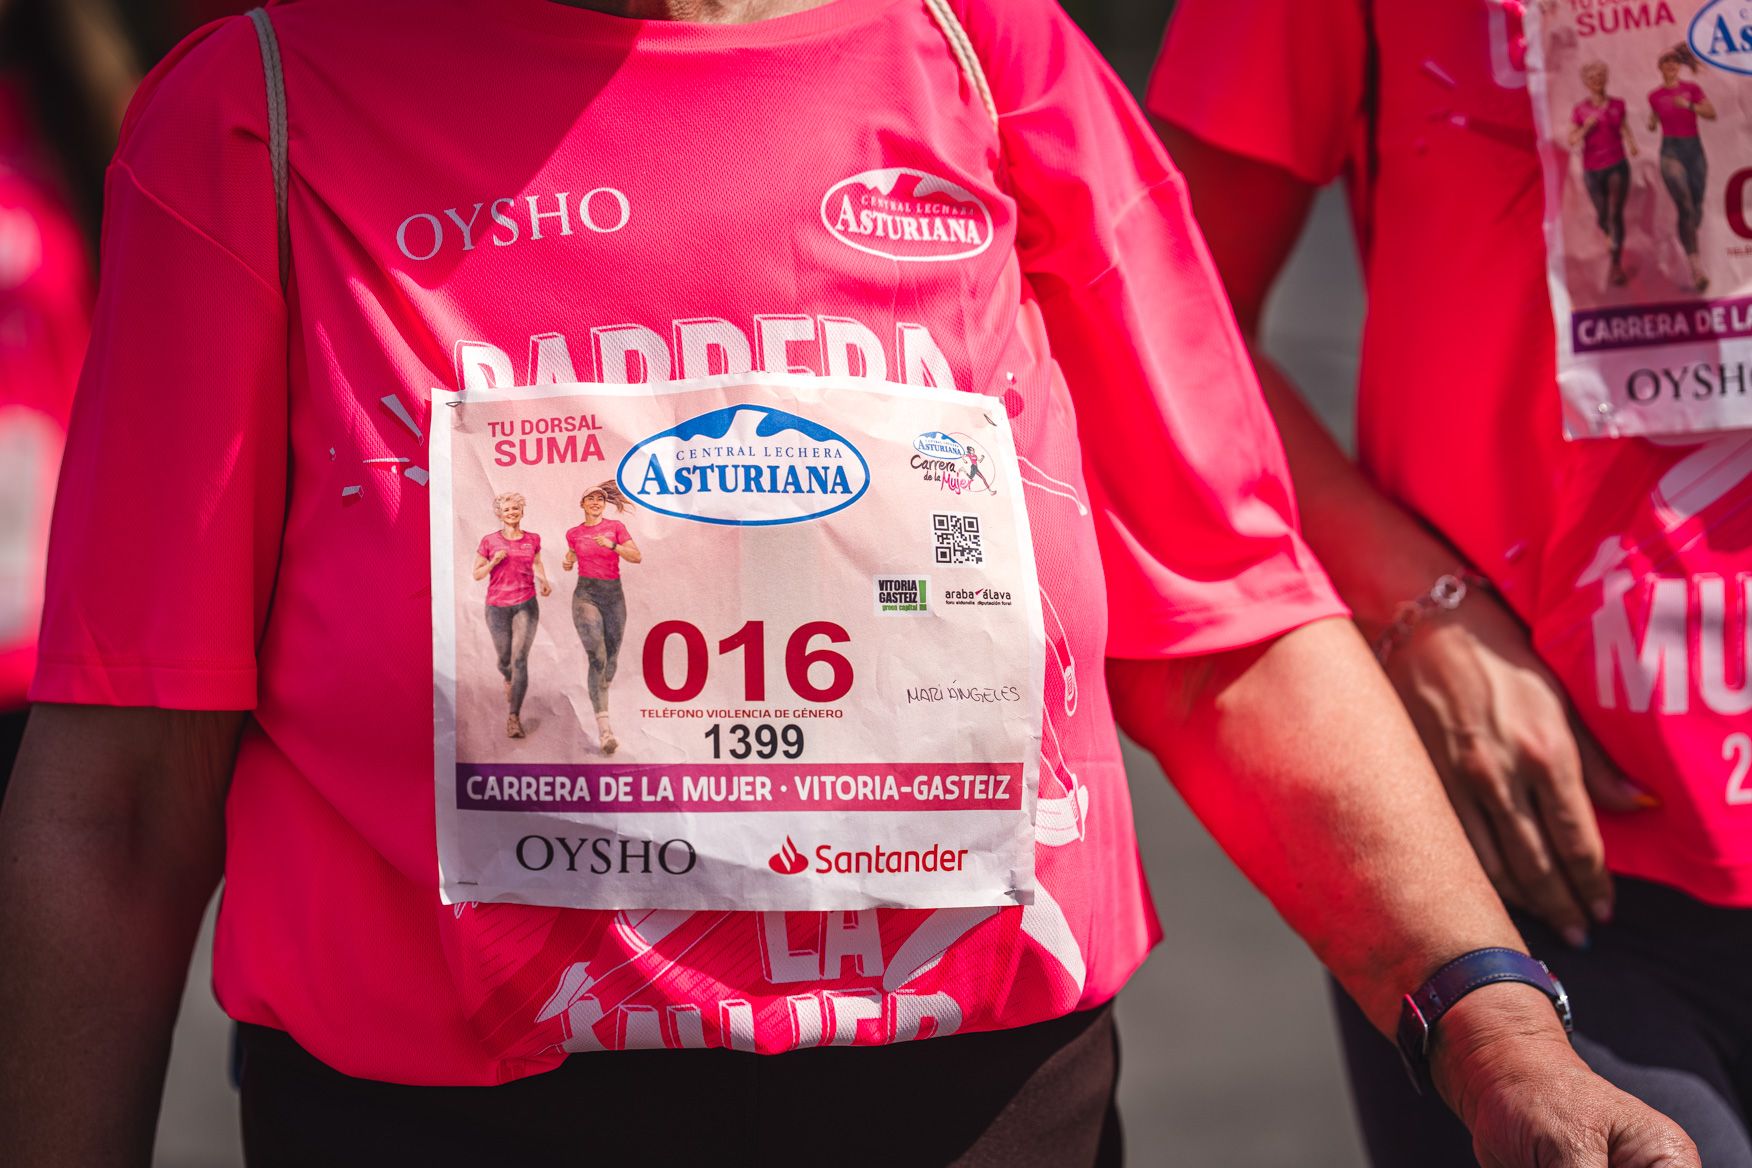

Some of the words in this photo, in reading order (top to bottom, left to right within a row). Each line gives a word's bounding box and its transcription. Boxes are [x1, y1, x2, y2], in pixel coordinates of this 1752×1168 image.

[1576, 2, 1677, 38] SUMA
[835, 194, 982, 245] ASTURIANA
[861, 195, 911, 212] CENTRAL
[916, 202, 975, 216] LECHERA
[396, 187, 631, 261] OYSHO
[1577, 312, 1690, 346] CARRERA
[1696, 306, 1727, 334] DE
[1627, 361, 1752, 404] OYSH
[488, 420, 514, 437] TU
[521, 414, 603, 436] DORSAL
[494, 433, 606, 467] SUMA
[676, 446, 756, 461] CENTRAL
[764, 446, 843, 459] LECHERA
[918, 439, 962, 456] ASTURIANA
[637, 453, 853, 495] ASTURIANA
[910, 454, 956, 473] Carrera
[923, 470, 933, 481] de
[934, 470, 941, 481] la
[940, 470, 974, 495] Mujer
[878, 579, 918, 591] VITORIA
[879, 592, 918, 603] GASTEIZ
[945, 589, 974, 600] araba
[982, 588, 1012, 600] álava
[642, 620, 854, 703] 016
[640, 707, 704, 719] TELÉFONO
[706, 709, 771, 719] VIOLENCIA
[774, 709, 790, 719] DE
[793, 707, 844, 719] GÉNERO
[704, 723, 805, 760] 1399
[466, 775, 591, 802] CARRERA
[599, 776, 633, 802] DE
[641, 776, 675, 802] LA
[682, 776, 773, 802] MUJER
[794, 774, 1012, 802] VITORIA-GASTEIZ
[515, 834, 697, 875] OYSHO
[815, 843, 969, 875] Santander
